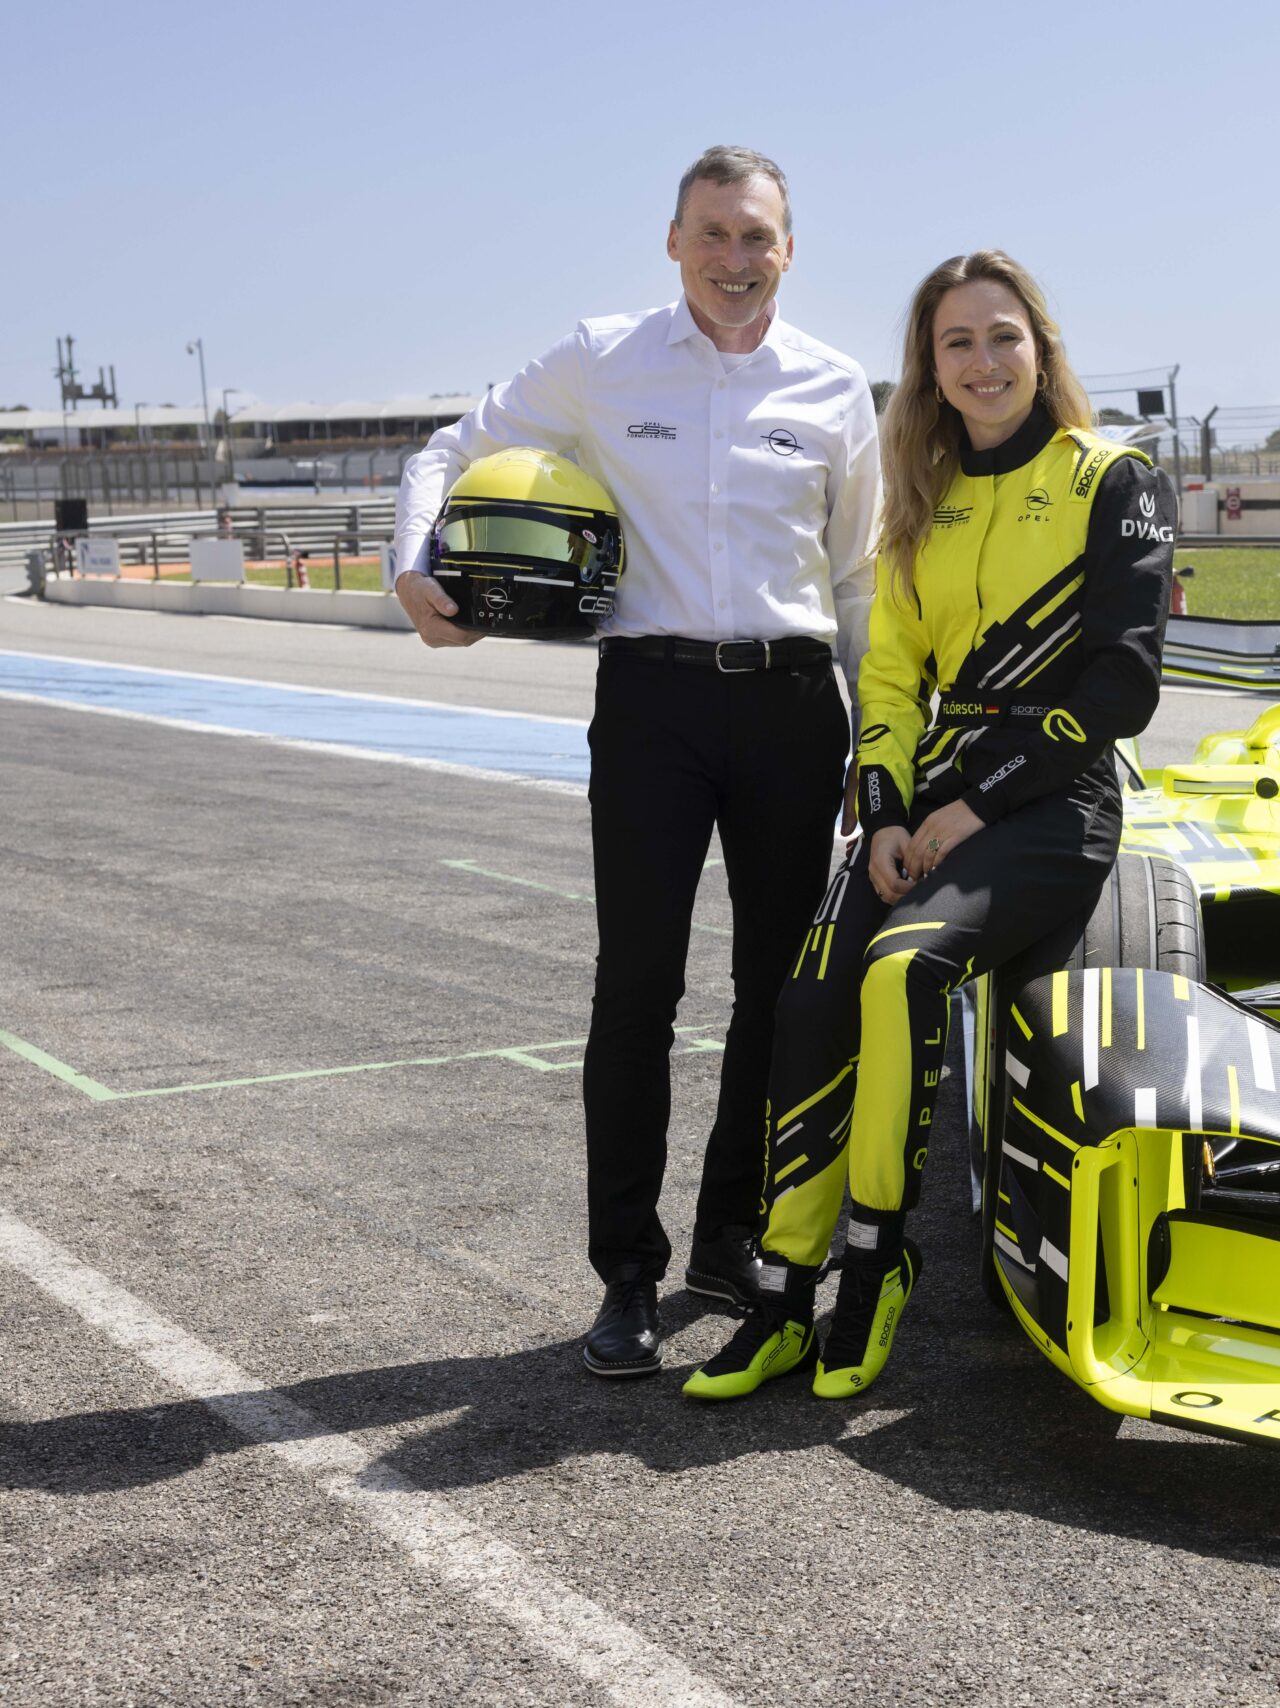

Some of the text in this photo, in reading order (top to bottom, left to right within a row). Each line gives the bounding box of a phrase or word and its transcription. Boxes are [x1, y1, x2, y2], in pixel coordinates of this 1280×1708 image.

[627, 425, 677, 436] GSE
[1075, 449, 1112, 499] sparco
[932, 507, 973, 523] SE
[1017, 514, 1050, 522] OPEL
[1121, 519, 1174, 543] DVAG
[478, 611, 513, 620] OPEL
[979, 754, 1027, 793] sparco
[868, 771, 881, 814] sparco
[913, 1027, 941, 1170] OPEL
[879, 1306, 896, 1348] sparco
